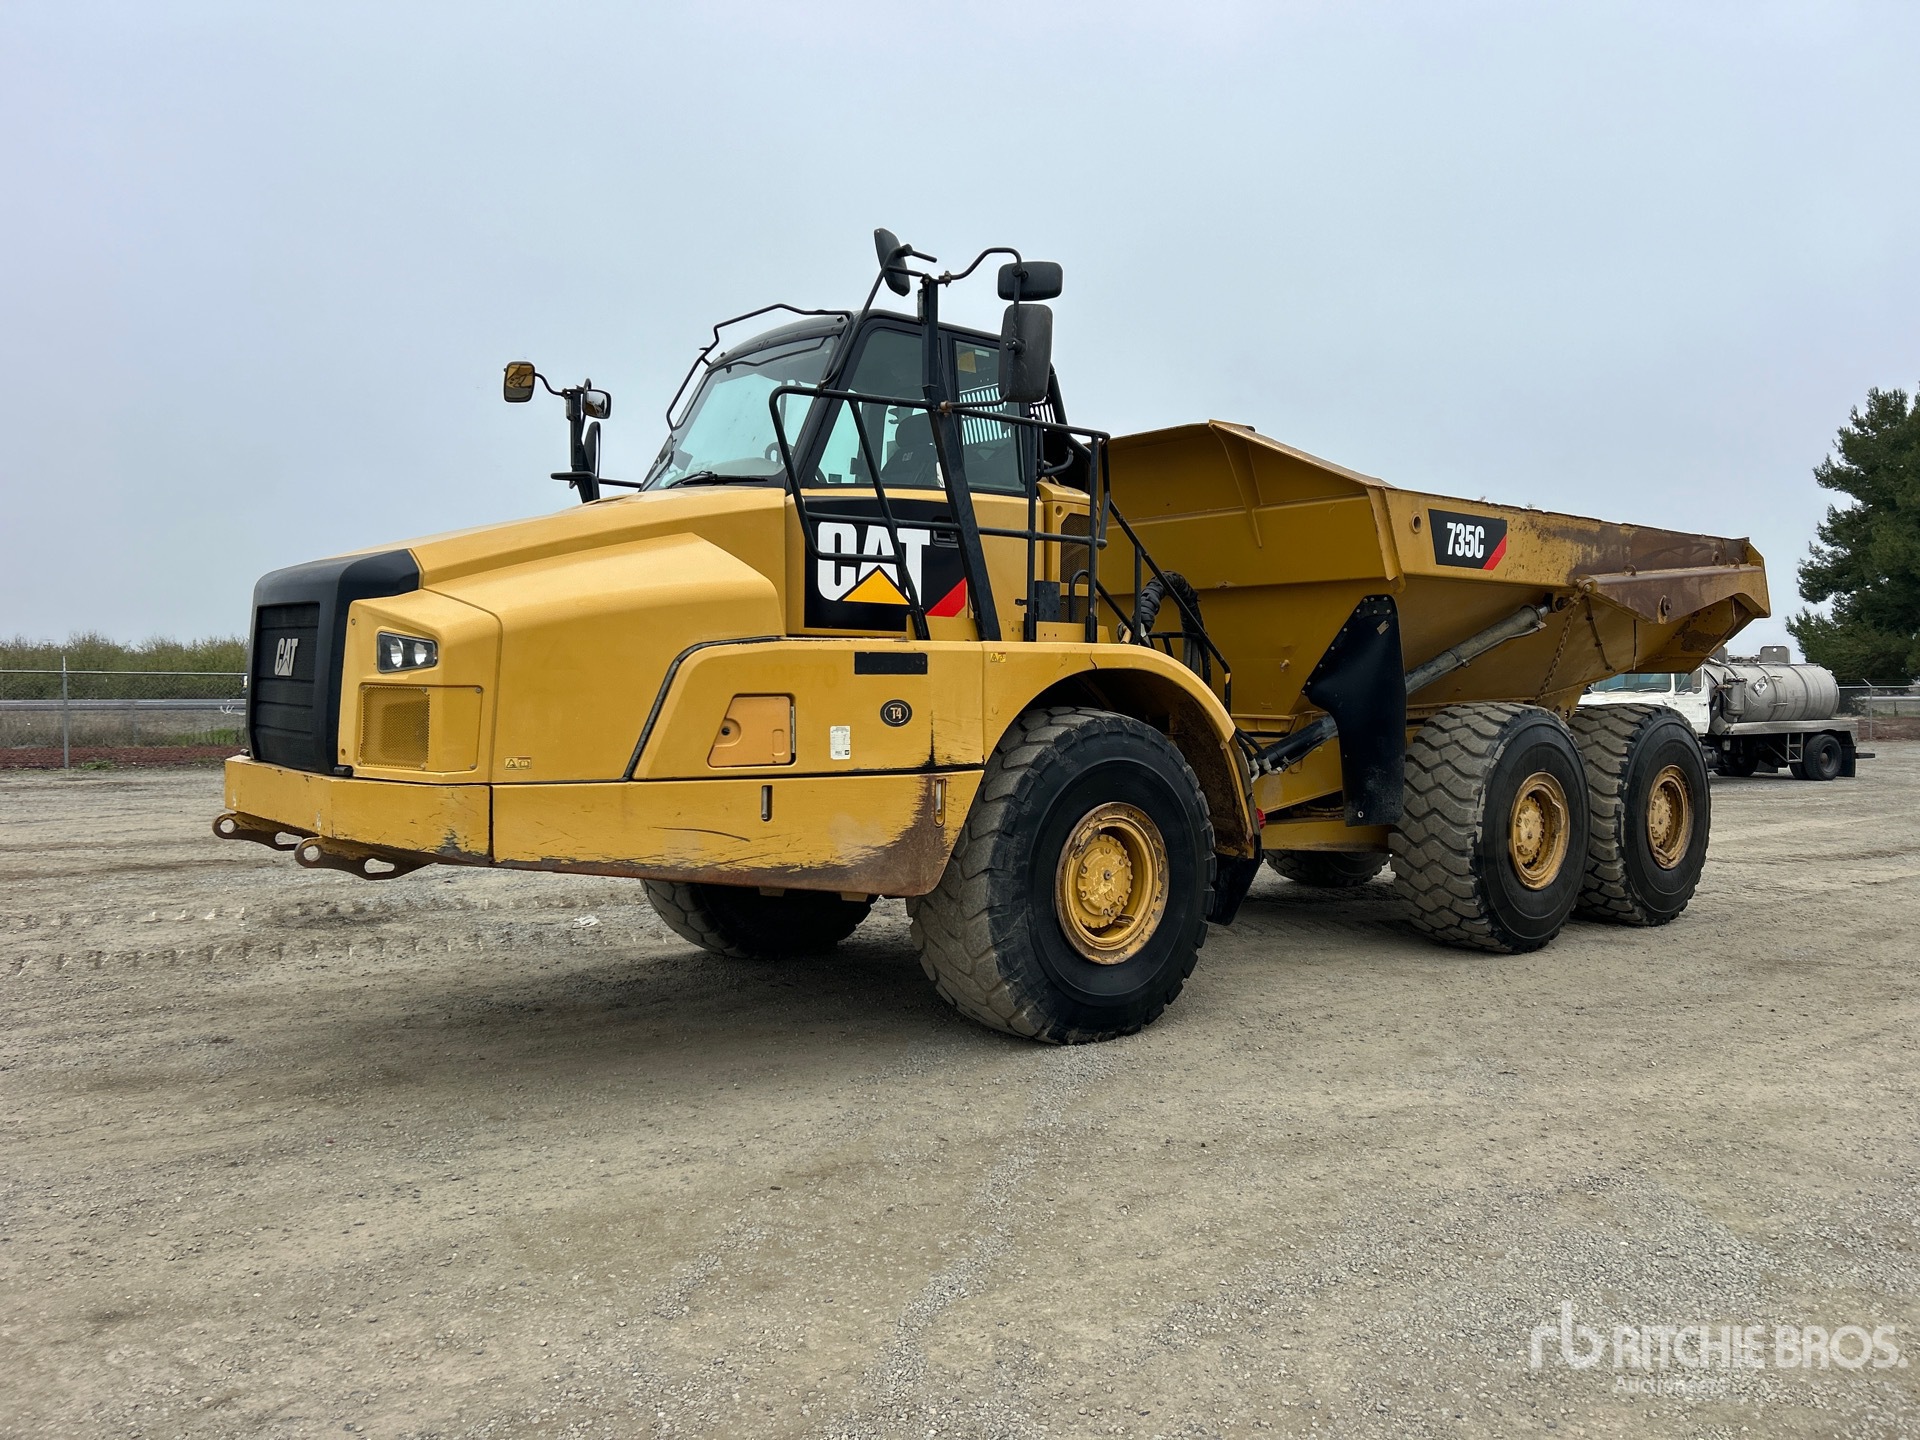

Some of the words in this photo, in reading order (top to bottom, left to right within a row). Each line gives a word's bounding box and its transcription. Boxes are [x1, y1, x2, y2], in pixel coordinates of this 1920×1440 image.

[1446, 521, 1485, 559] 735C
[818, 522, 930, 605] CAT
[274, 637, 299, 676] CAT
[890, 707, 902, 719] T4
